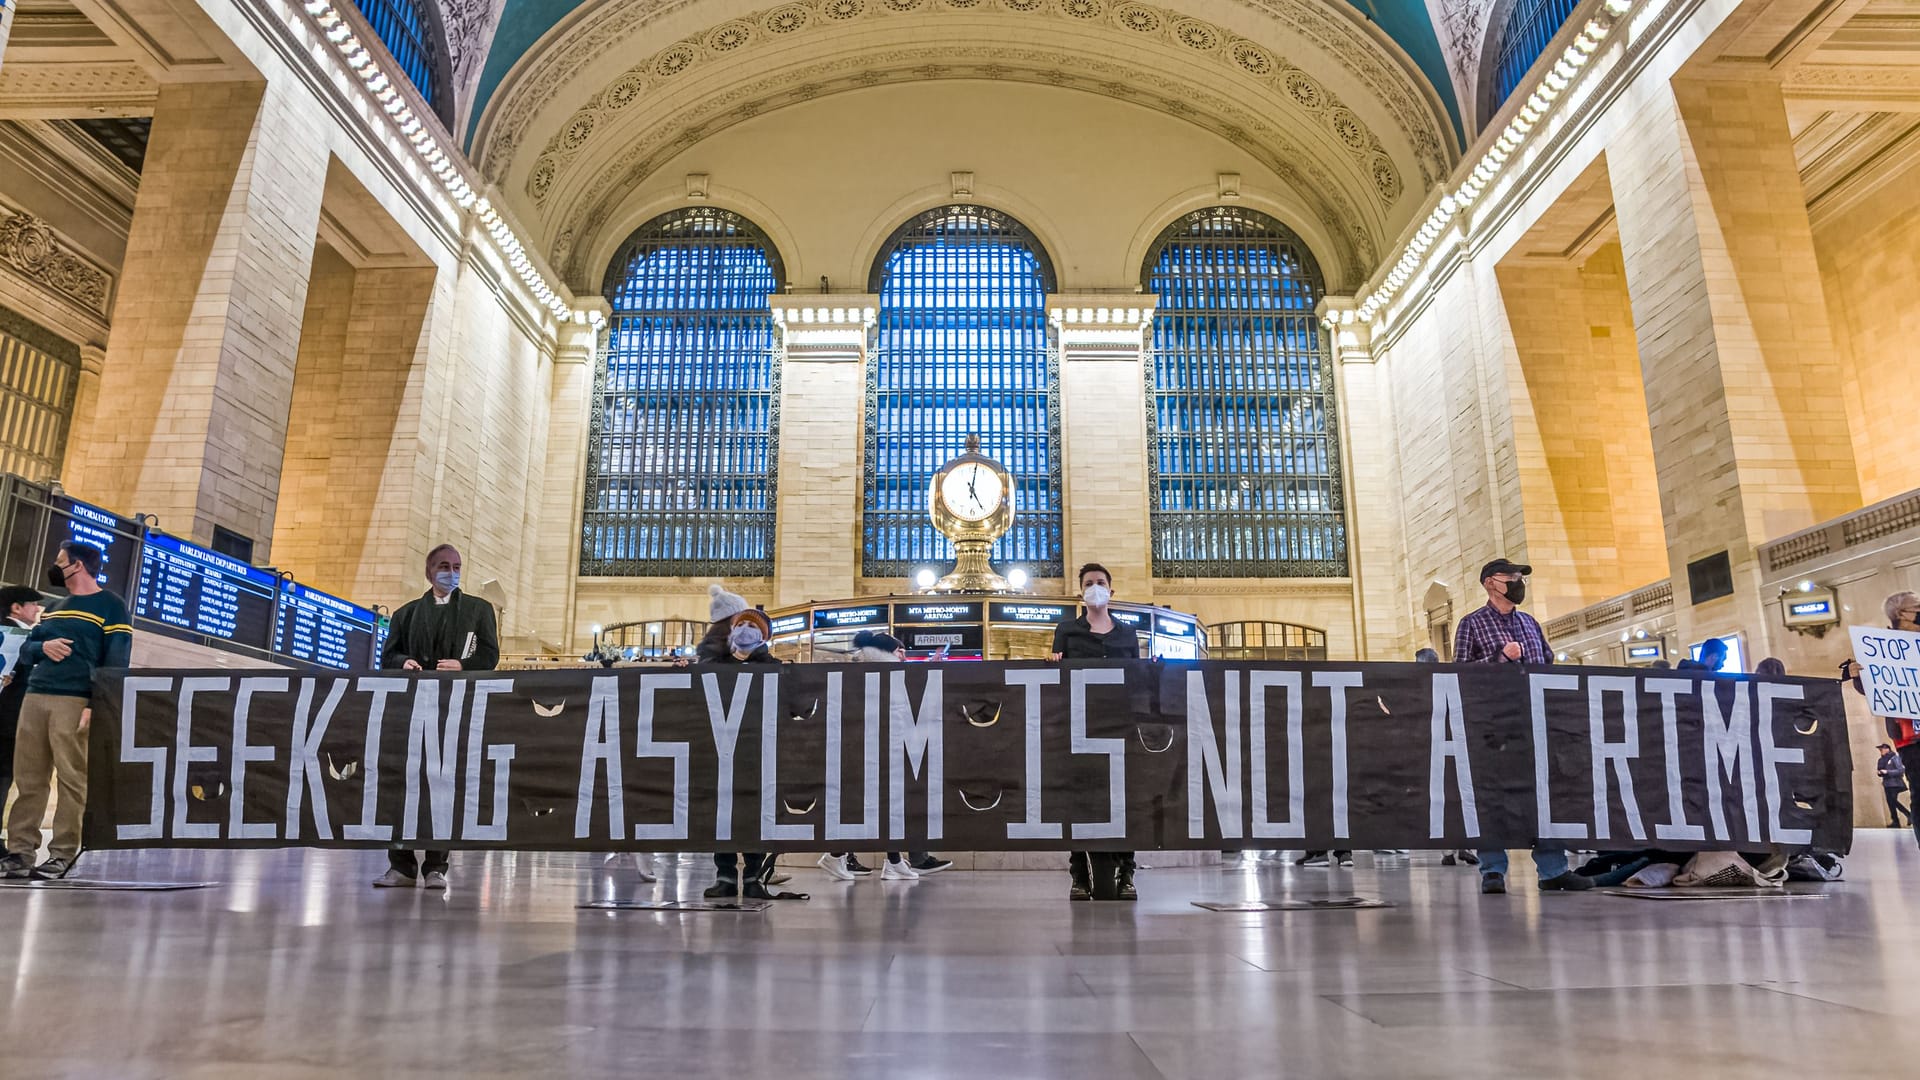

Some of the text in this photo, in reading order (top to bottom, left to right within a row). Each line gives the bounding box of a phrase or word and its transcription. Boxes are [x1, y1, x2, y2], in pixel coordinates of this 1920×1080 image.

[74, 505, 116, 527] INFORMATION
[180, 544, 247, 576] HARLEM LINE DEPARTURES
[839, 609, 877, 618] METRO-NORTH
[922, 606, 968, 614] METRO-NORTH
[837, 616, 867, 624] TIMETABLES
[917, 636, 960, 644] ARRIVALS
[1862, 636, 1910, 660] STOP
[117, 669, 1812, 844] SEEKING ASYLUM IS NOT A CRIME
